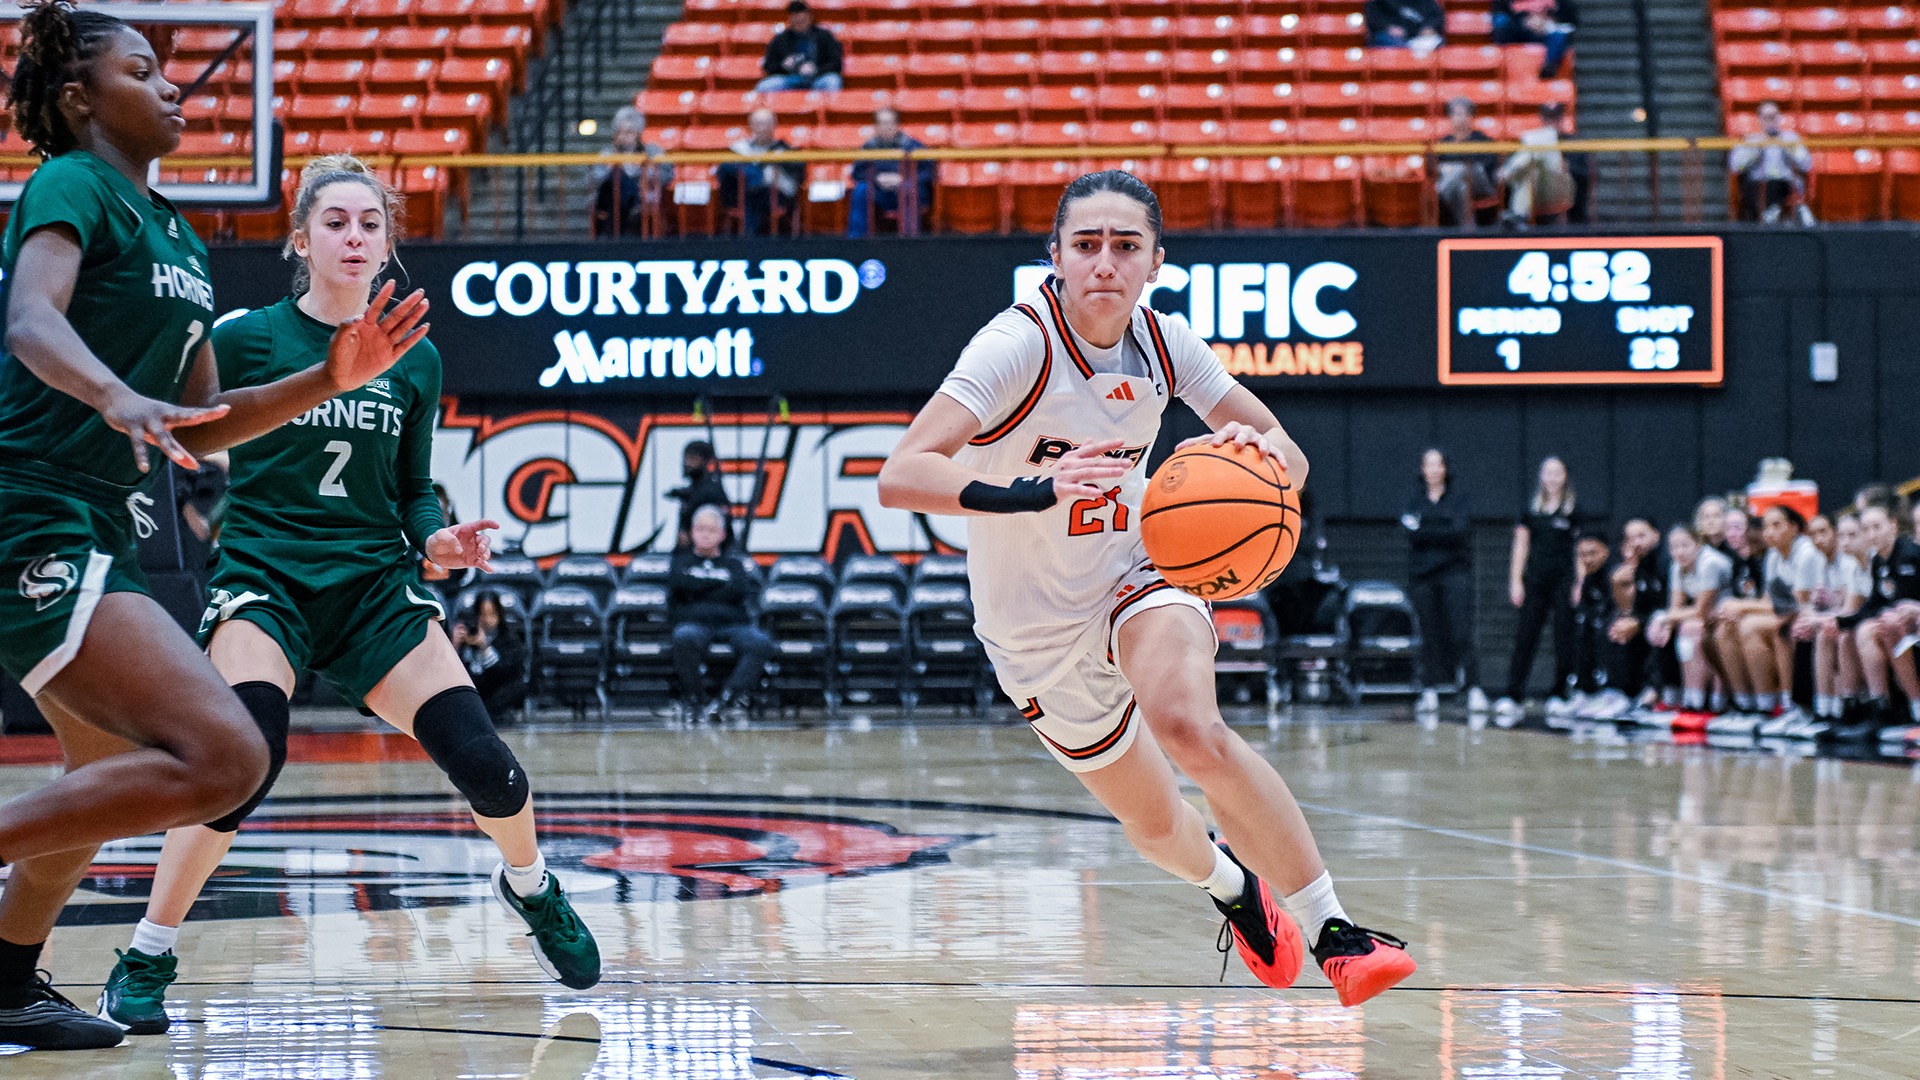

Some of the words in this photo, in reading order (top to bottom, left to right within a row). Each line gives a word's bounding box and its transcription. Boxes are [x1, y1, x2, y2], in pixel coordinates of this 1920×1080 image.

[451, 258, 862, 317] COURTYARD
[1507, 249, 1652, 303] 4:52
[1458, 307, 1562, 335] PERIOD
[538, 328, 754, 388] Marriott
[1496, 338, 1521, 371] 1
[1628, 336, 1680, 370] 23
[283, 398, 403, 437] ORNETS
[318, 440, 352, 497] 2
[1068, 485, 1129, 536] 21
[1177, 568, 1241, 596] NCA
